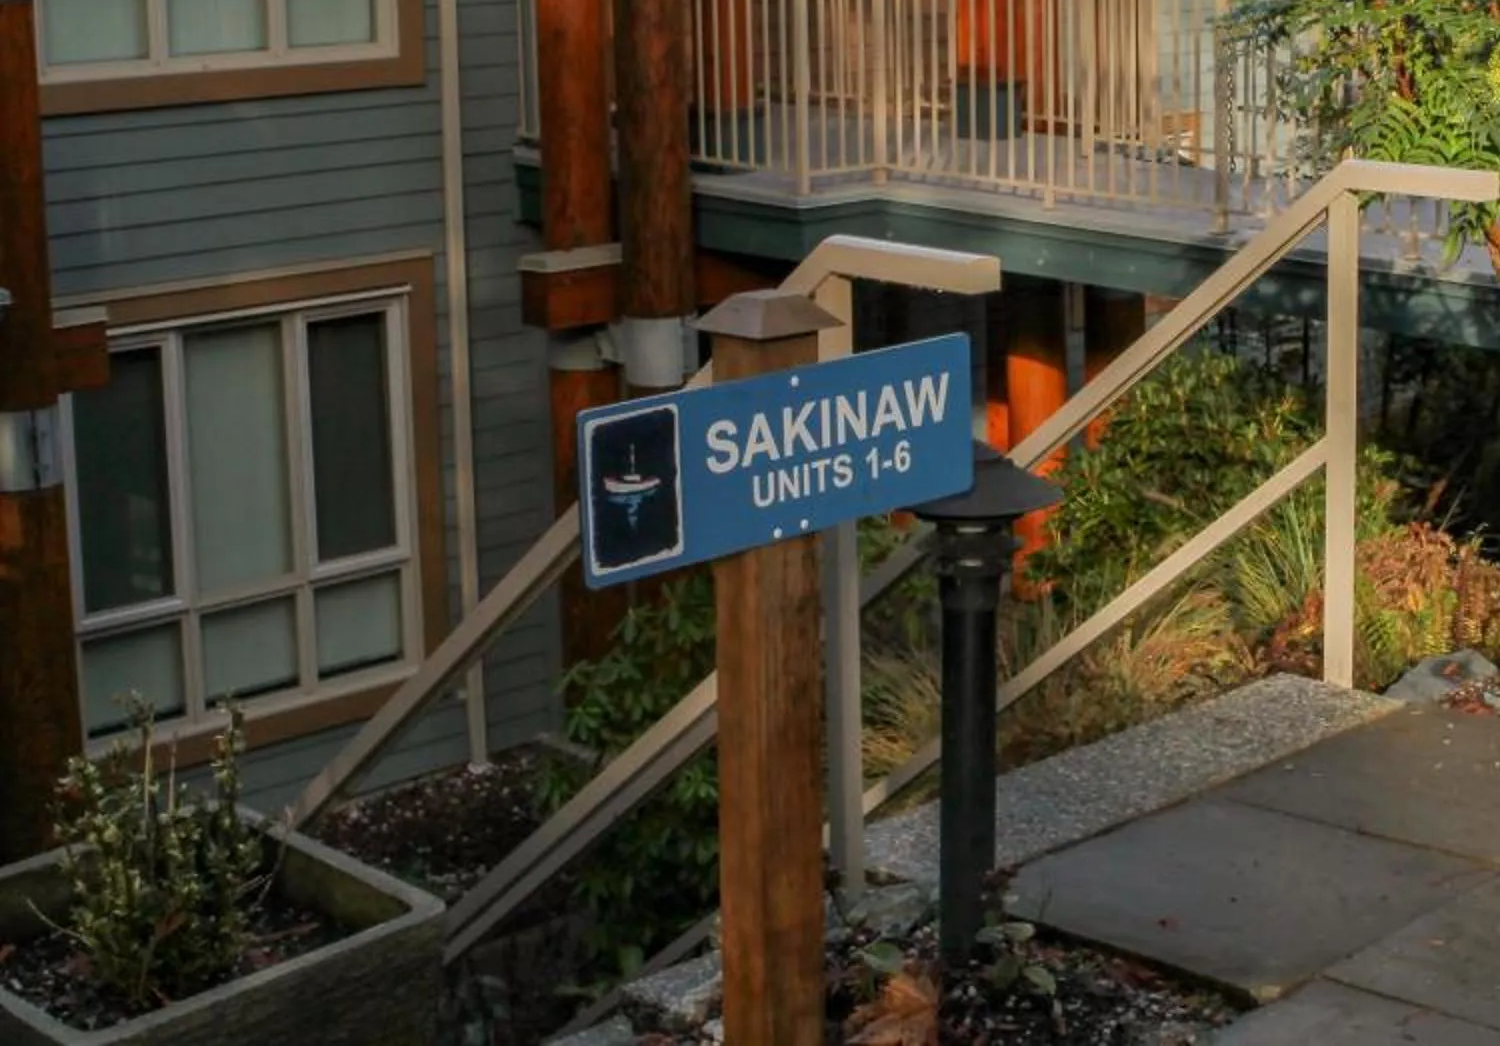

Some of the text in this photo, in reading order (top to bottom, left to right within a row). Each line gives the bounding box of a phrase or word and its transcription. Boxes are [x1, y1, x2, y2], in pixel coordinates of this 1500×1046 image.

[706, 372, 950, 474] SAKINAW
[753, 440, 911, 508] UNITS 1-6
